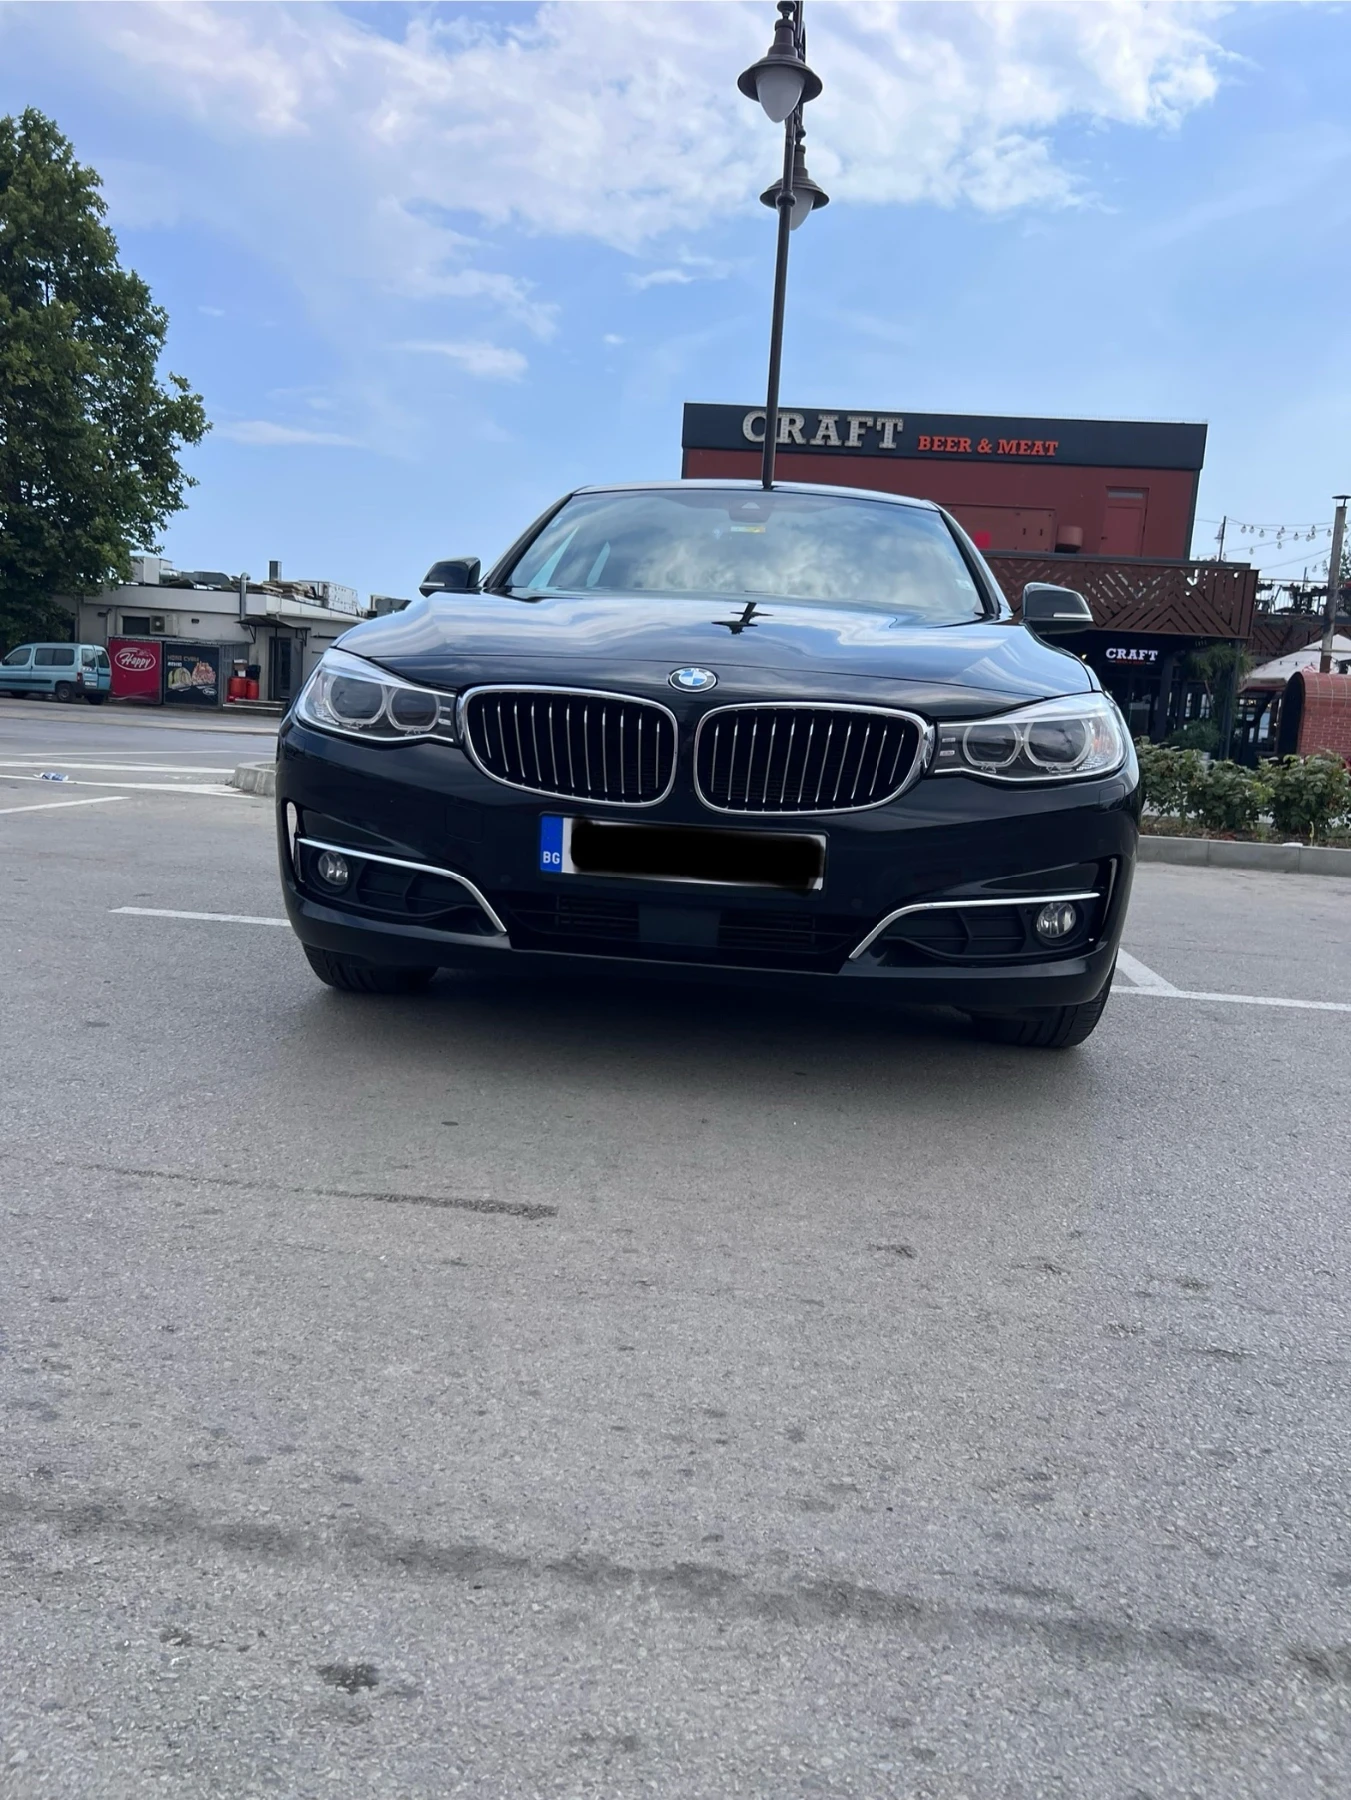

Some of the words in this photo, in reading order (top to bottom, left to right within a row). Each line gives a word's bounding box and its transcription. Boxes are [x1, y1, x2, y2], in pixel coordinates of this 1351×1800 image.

[742, 410, 904, 449] CRAFT
[918, 435, 972, 453] BEER
[977, 438, 993, 454] &
[997, 439, 1059, 457] MEAT
[120, 653, 151, 668] Happy
[1105, 648, 1159, 661] CRAFT
[543, 851, 560, 864] BG
